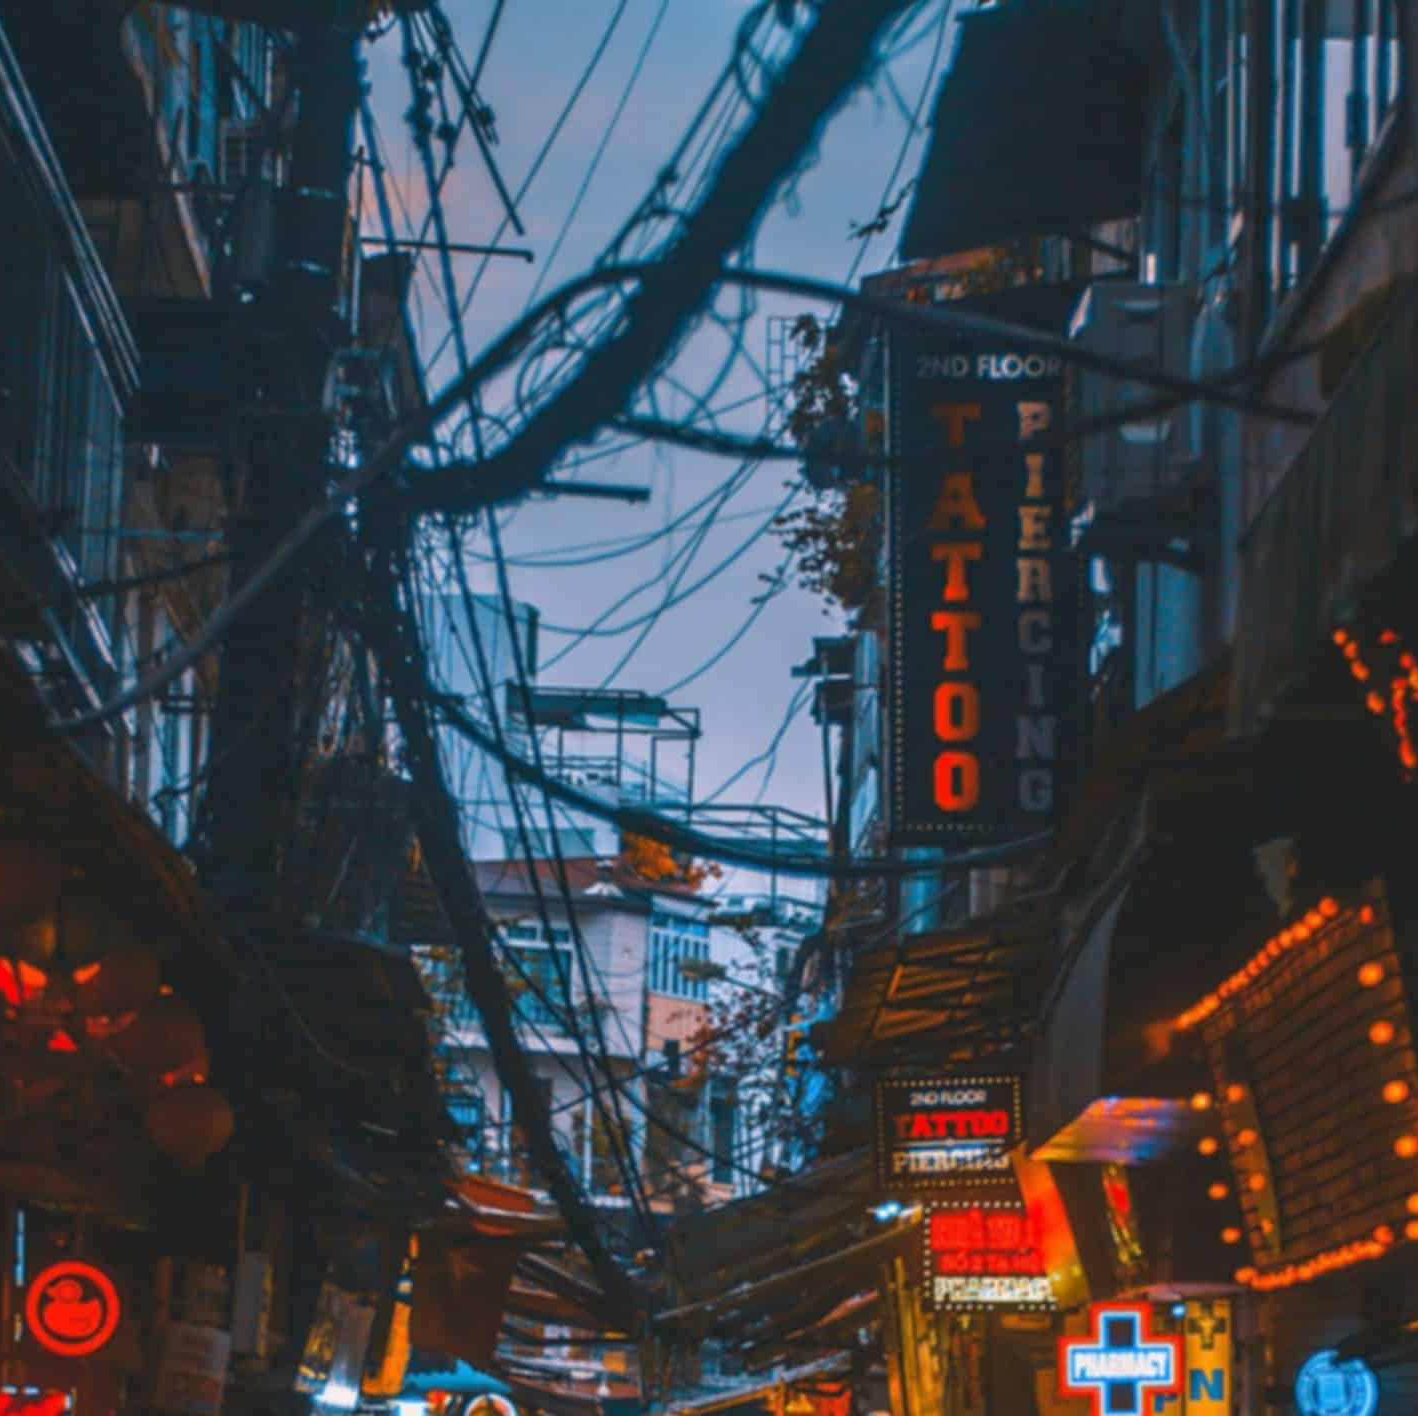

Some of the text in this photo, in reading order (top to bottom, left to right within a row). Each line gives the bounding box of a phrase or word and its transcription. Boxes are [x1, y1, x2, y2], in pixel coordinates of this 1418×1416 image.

[917, 353, 1063, 380] 2ND FLOOR
[929, 401, 986, 813] TATTOO
[1014, 400, 1054, 812] PIERCING
[892, 1109, 1010, 1139] TATTOO
